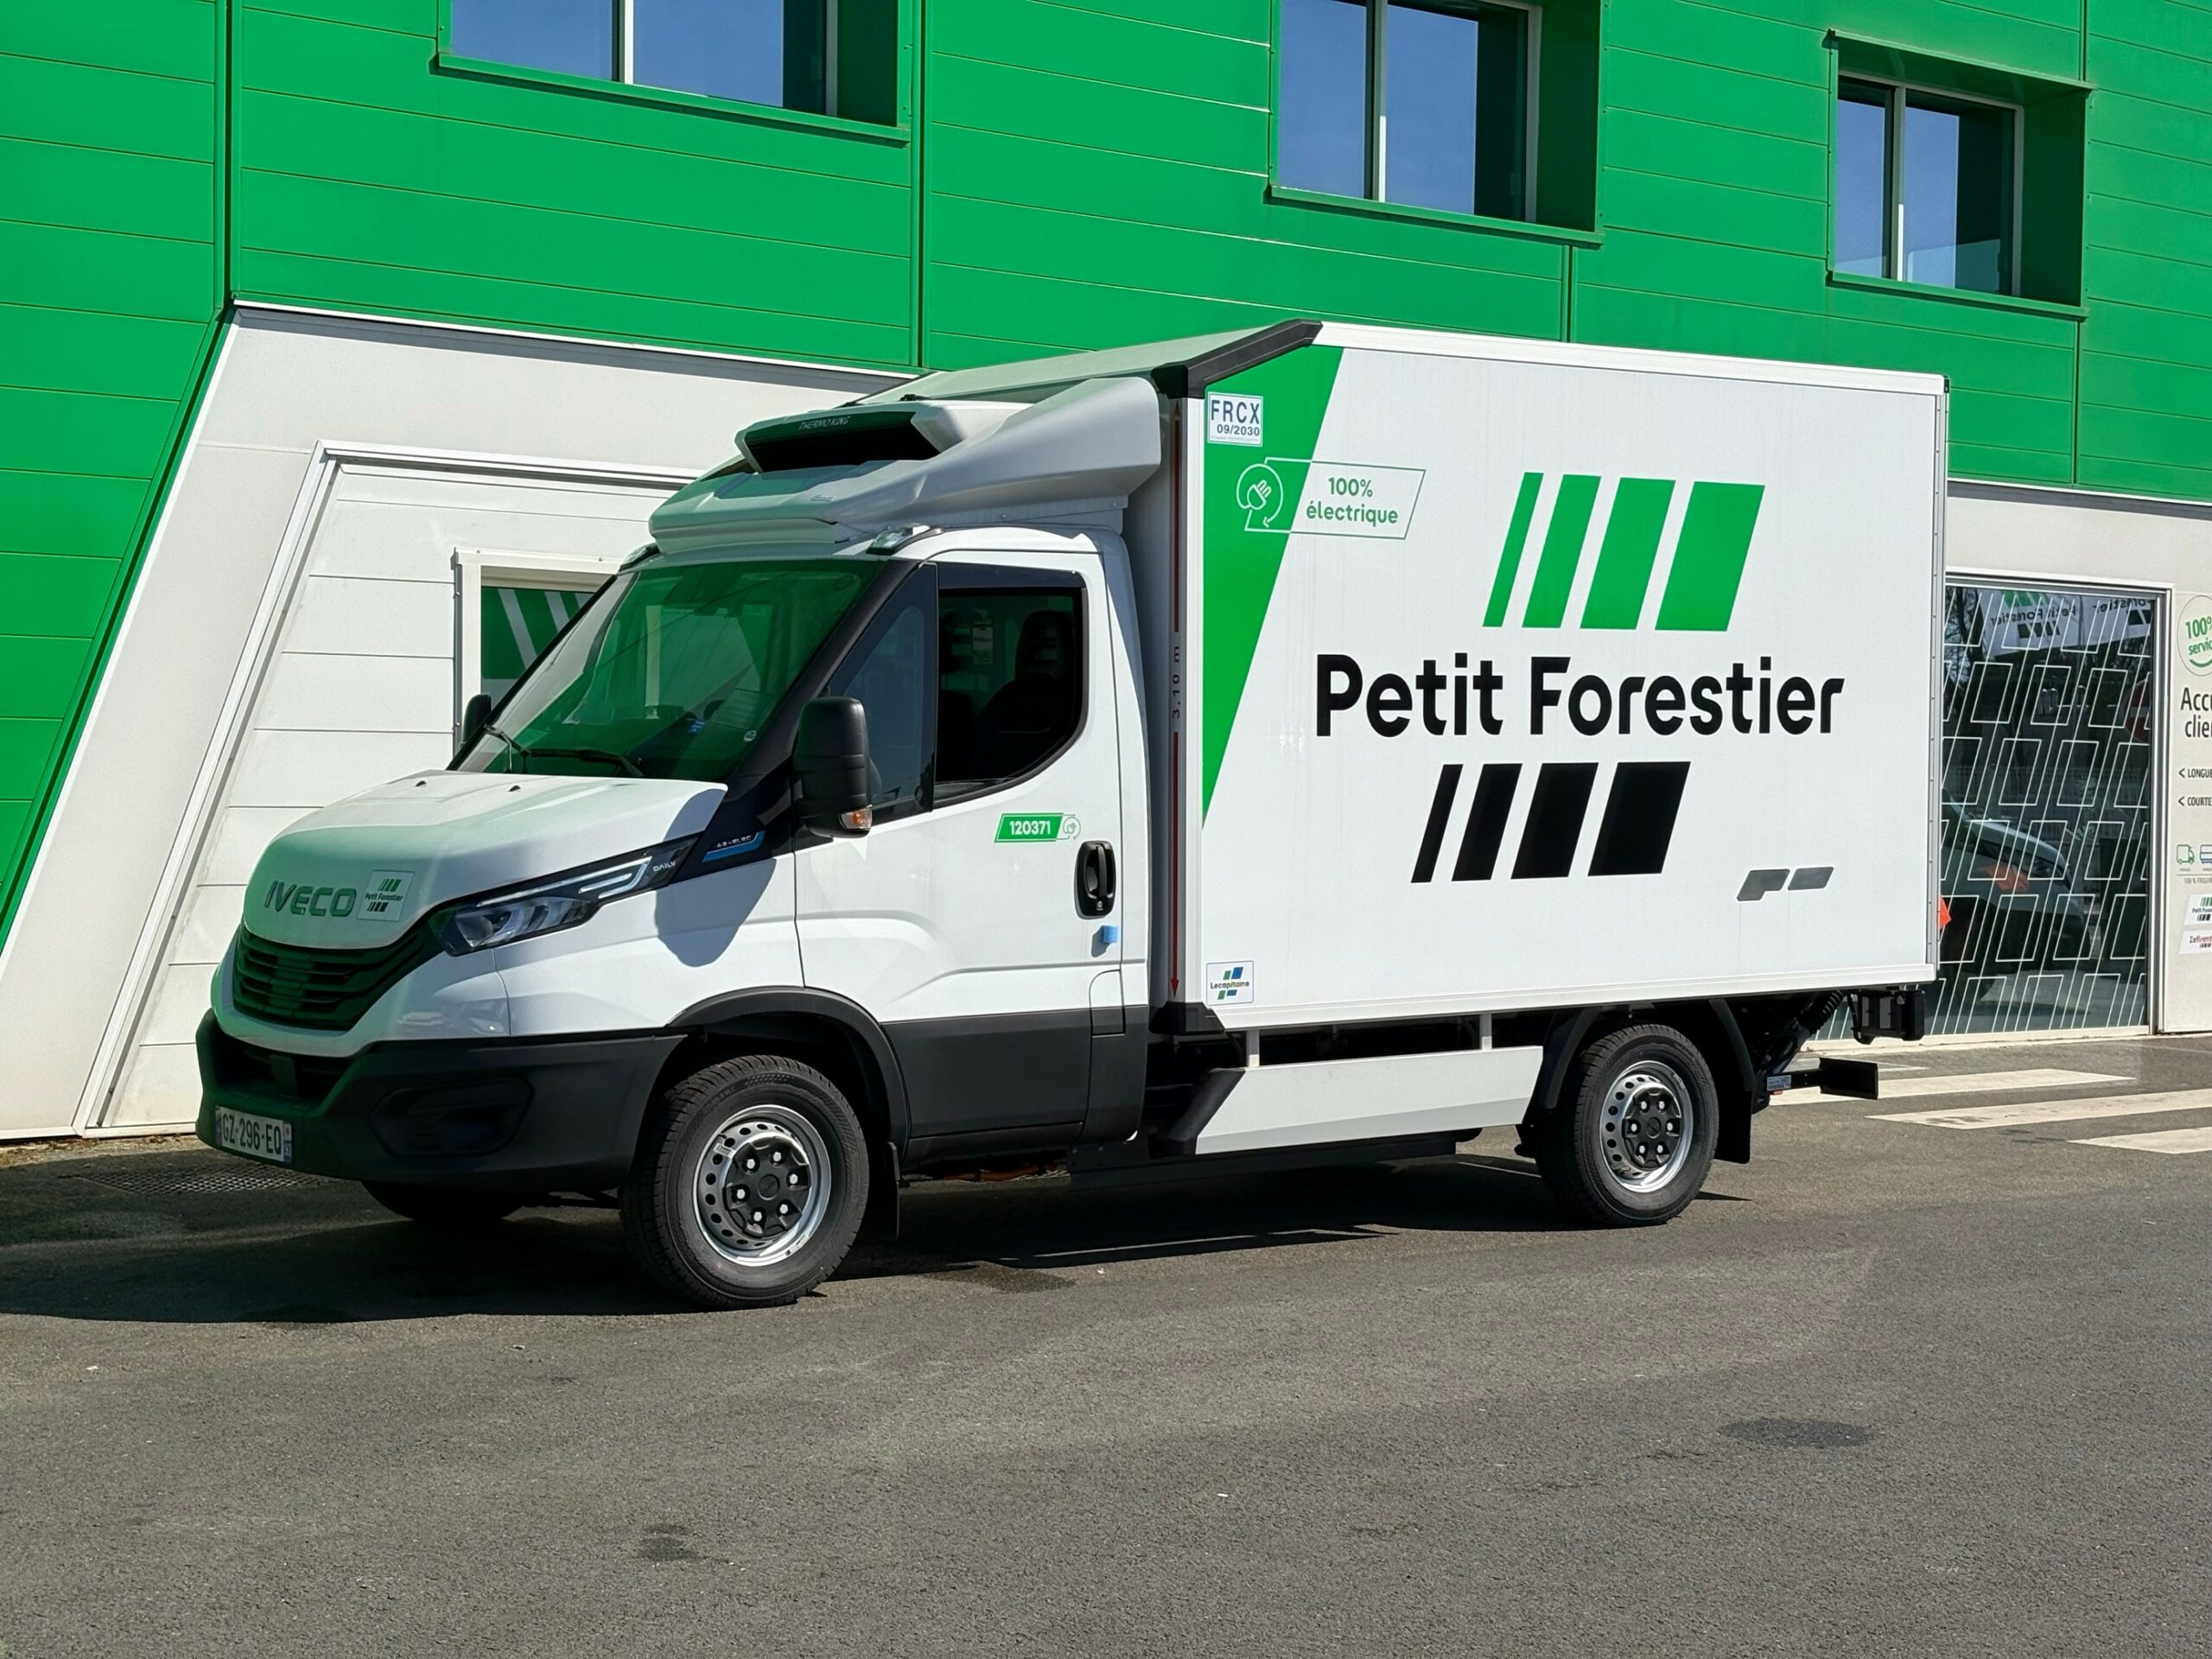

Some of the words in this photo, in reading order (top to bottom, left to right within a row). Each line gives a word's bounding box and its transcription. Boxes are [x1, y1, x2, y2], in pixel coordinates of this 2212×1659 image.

[1210, 399, 1261, 424] FRCX
[830, 416, 851, 426] KING
[1216, 423, 1261, 436] 09/2030
[1327, 477, 1374, 498] 100%
[1306, 500, 1398, 527] électrique
[1316, 652, 1503, 738] Petit
[1529, 656, 1846, 736] Forestier
[1008, 820, 1052, 836] 120371
[652, 860, 677, 872] DAILY
[264, 880, 358, 917] IVECO
[365, 892, 378, 900] Petit
[378, 893, 404, 901] Forestier
[1210, 981, 1250, 989] Lecapitaine
